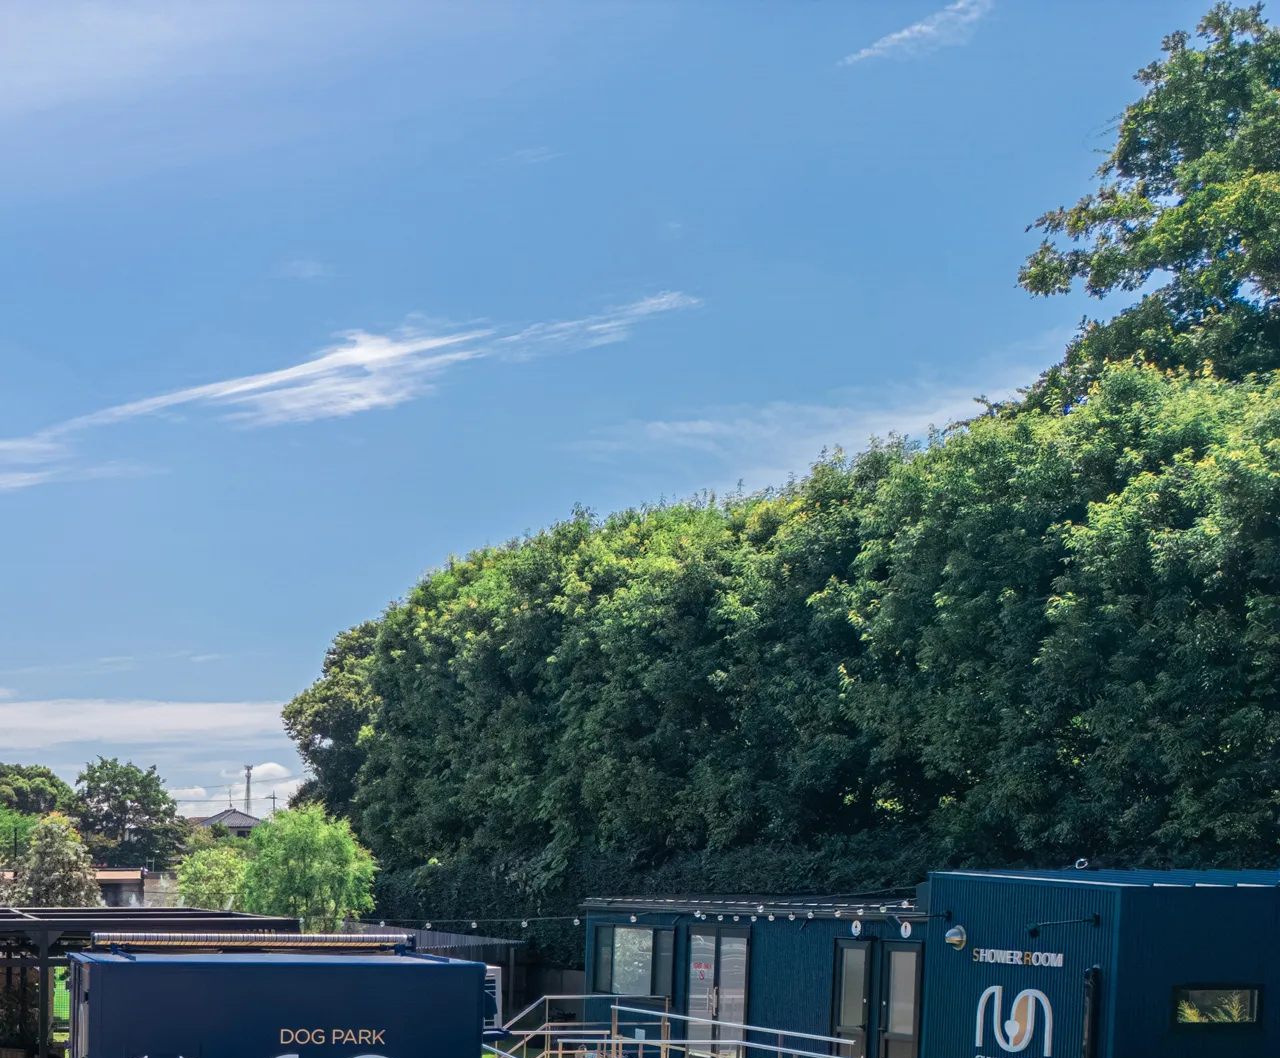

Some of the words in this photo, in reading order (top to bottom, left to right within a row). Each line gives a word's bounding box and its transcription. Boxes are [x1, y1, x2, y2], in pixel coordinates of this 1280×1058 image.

[972, 947, 1023, 965] SHOWER
[1023, 951, 1064, 967] ROOM
[279, 1029, 326, 1045] DOG
[331, 1029, 386, 1045] PARK
